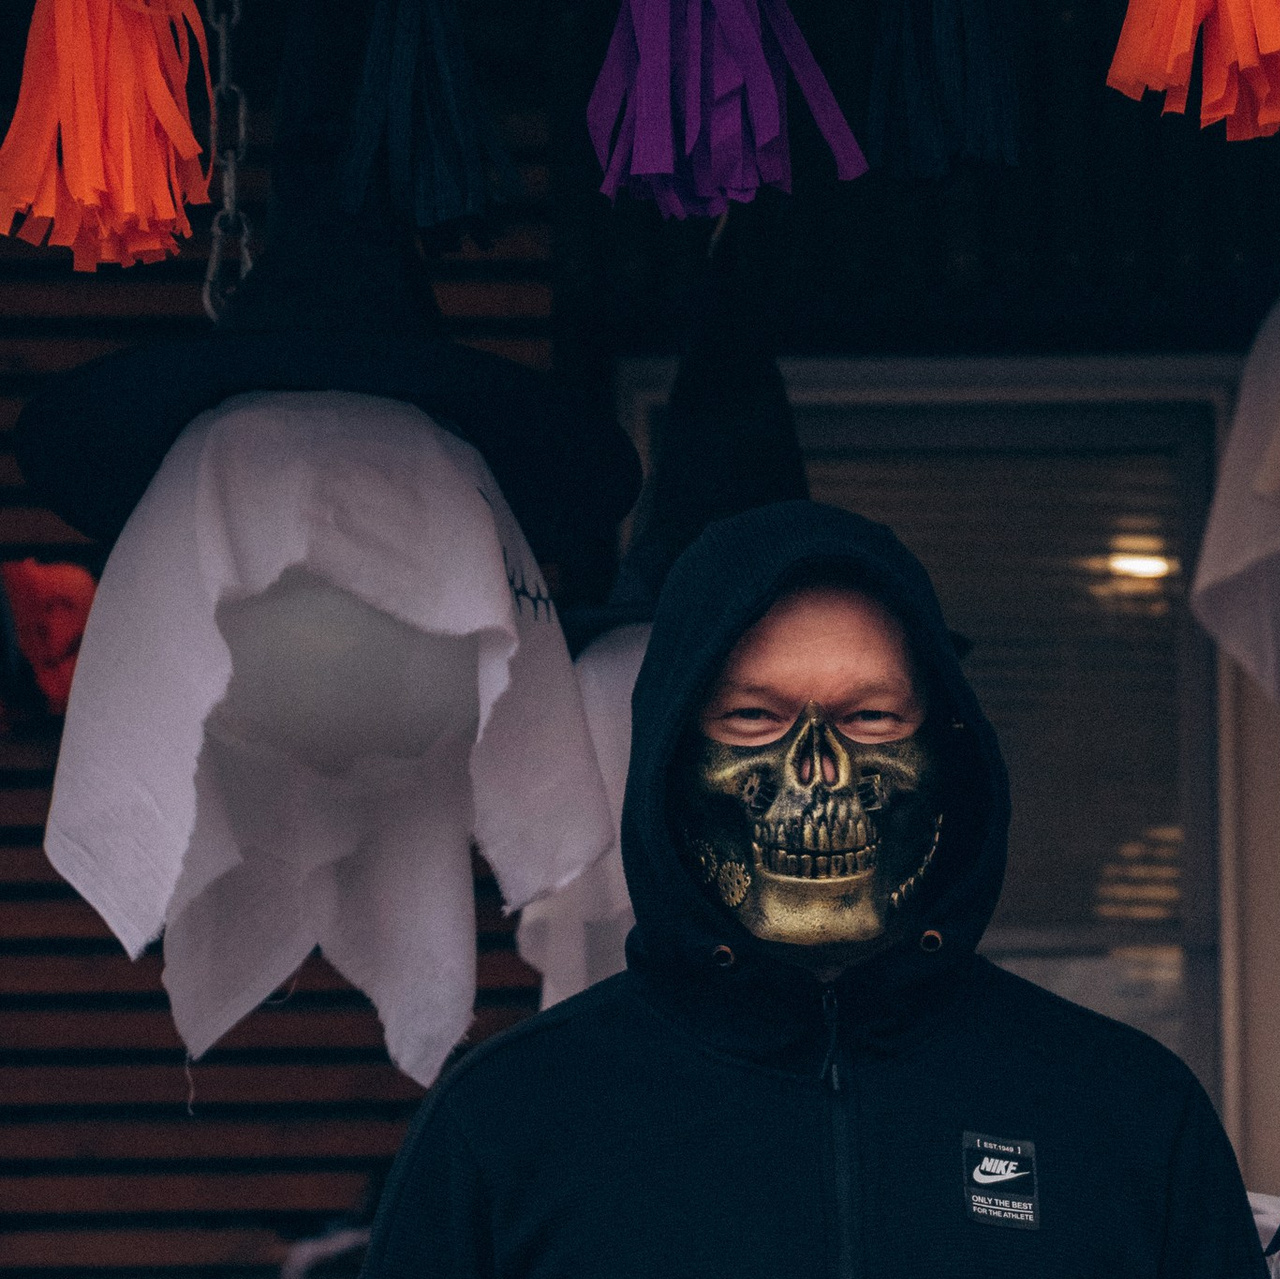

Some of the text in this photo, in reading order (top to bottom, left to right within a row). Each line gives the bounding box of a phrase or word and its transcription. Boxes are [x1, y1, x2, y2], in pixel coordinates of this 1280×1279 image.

[980, 1156, 1019, 1175] NIKE
[972, 1195, 1033, 1210] ONLY THE BEST
[973, 1206, 1034, 1222] FOR THE ATHLETE
